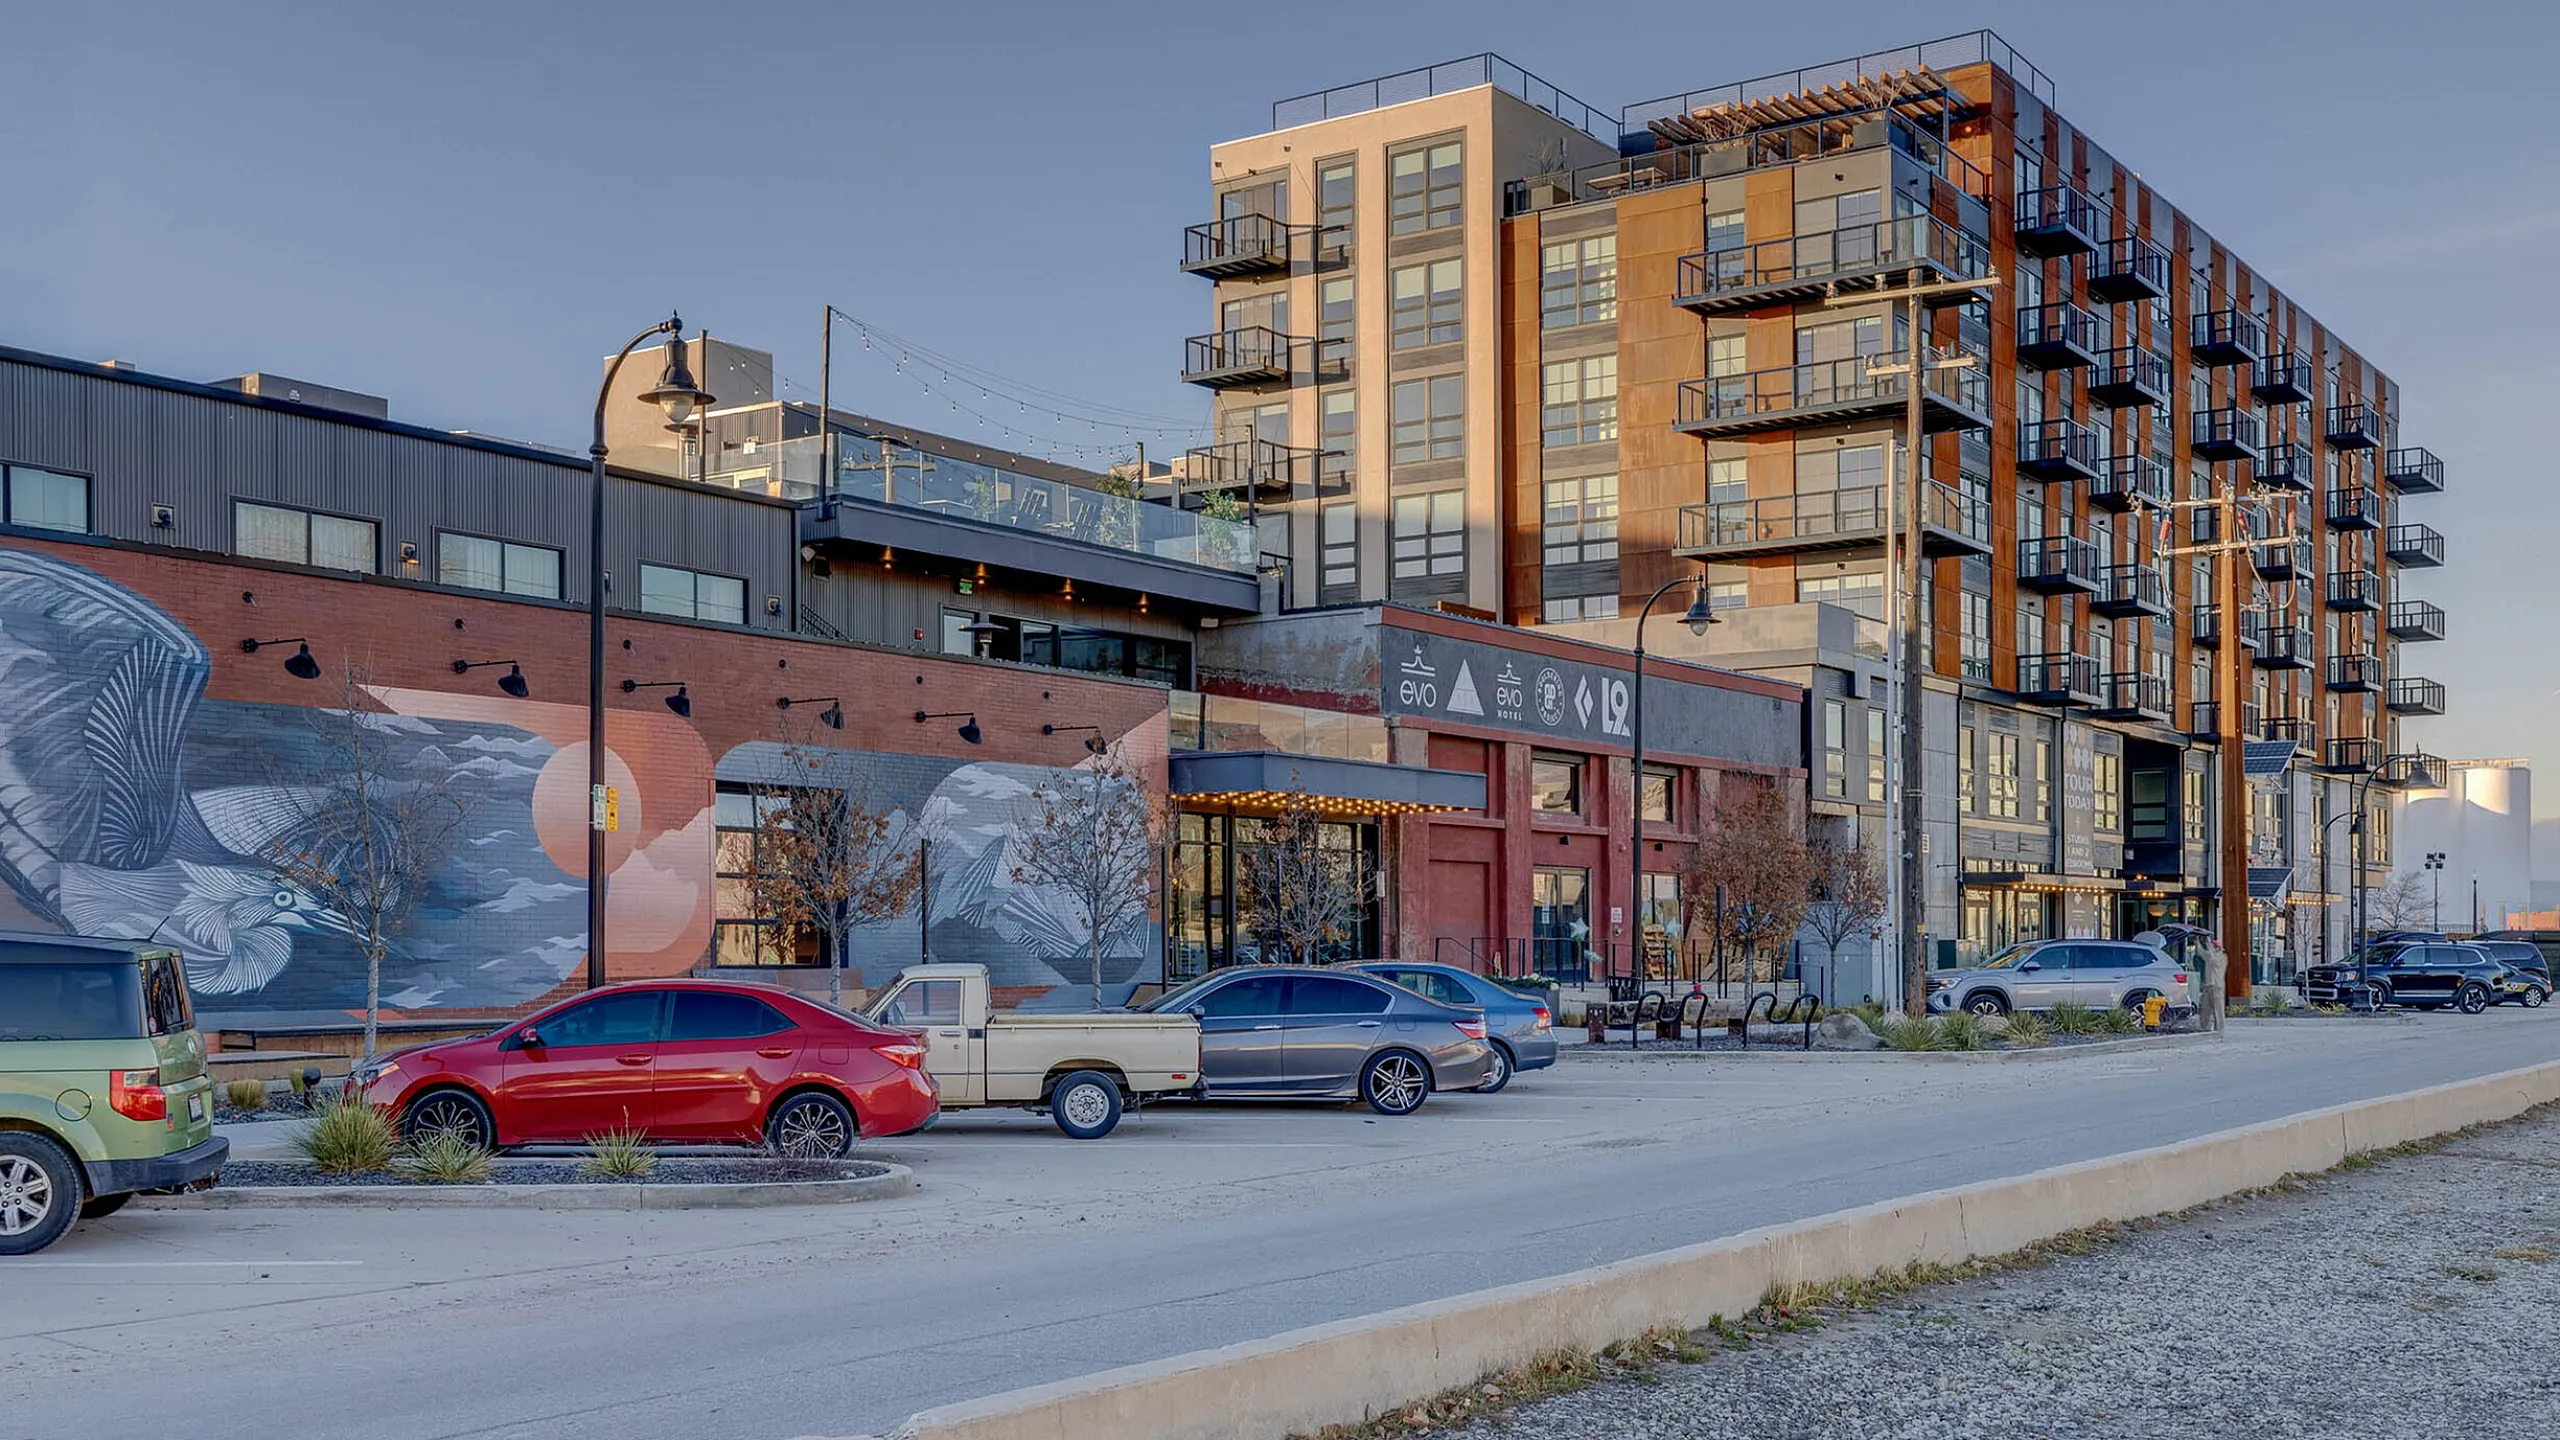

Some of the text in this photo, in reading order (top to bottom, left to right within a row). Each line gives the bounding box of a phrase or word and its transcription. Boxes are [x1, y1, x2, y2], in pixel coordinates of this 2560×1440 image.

[1400, 680, 1437, 708] evo
[1497, 687, 1523, 708] evo
[1497, 709, 1522, 720] HOTEL
[2064, 773, 2093, 793] TOUR
